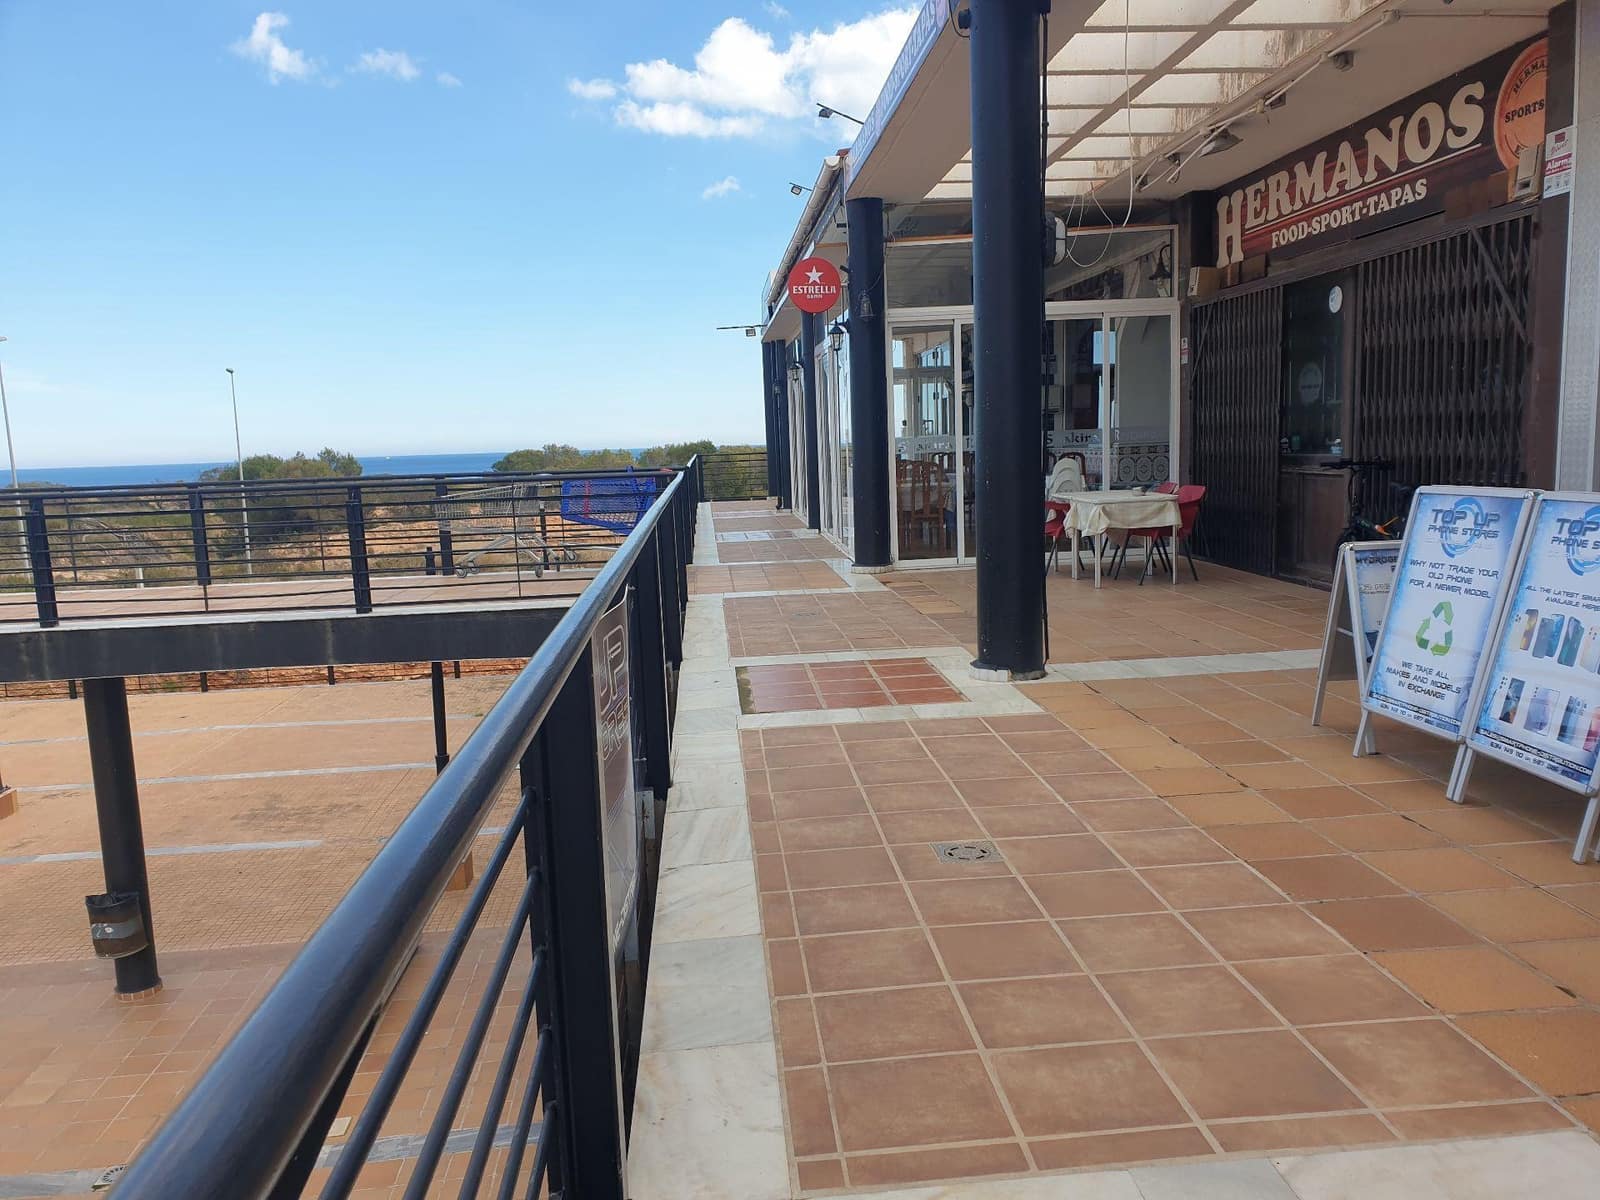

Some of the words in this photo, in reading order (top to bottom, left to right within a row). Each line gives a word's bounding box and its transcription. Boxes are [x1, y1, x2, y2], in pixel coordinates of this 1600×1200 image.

[1504, 99, 1545, 124] SPORTS
[1216, 81, 1485, 269] HERMANOS
[792, 285, 837, 294] ESTRELLA
[1431, 508, 1468, 525] TOP
[1473, 511, 1501, 528] UP
[1556, 518, 1600, 537] TOP
[1427, 524, 1459, 535] PHONE
[1461, 527, 1500, 540] STORES
[1550, 536, 1589, 549] PHONE
[1410, 559, 1426, 568] WHY
[1428, 562, 1445, 570] NOT
[1448, 564, 1475, 575] TRADE
[1478, 568, 1499, 579] YOUR
[1428, 571, 1444, 580] OLD
[1446, 574, 1473, 585] PHONE
[1409, 579, 1425, 588] FOR
[1435, 583, 1463, 595] NEWER
[1464, 587, 1492, 599] MODEL
[1553, 589, 1580, 599] LATEST
[1545, 596, 1580, 608] AVAILABLE
[1386, 666, 1411, 679] MAKES
[1412, 674, 1429, 684] AND
[1430, 679, 1461, 694] MODELS
[1402, 661, 1413, 670] WE
[1415, 664, 1433, 676] TAKE
[1436, 670, 1450, 680] ALL
[1398, 680, 1406, 688] IN
[1407, 683, 1446, 700] EXCHANGE
